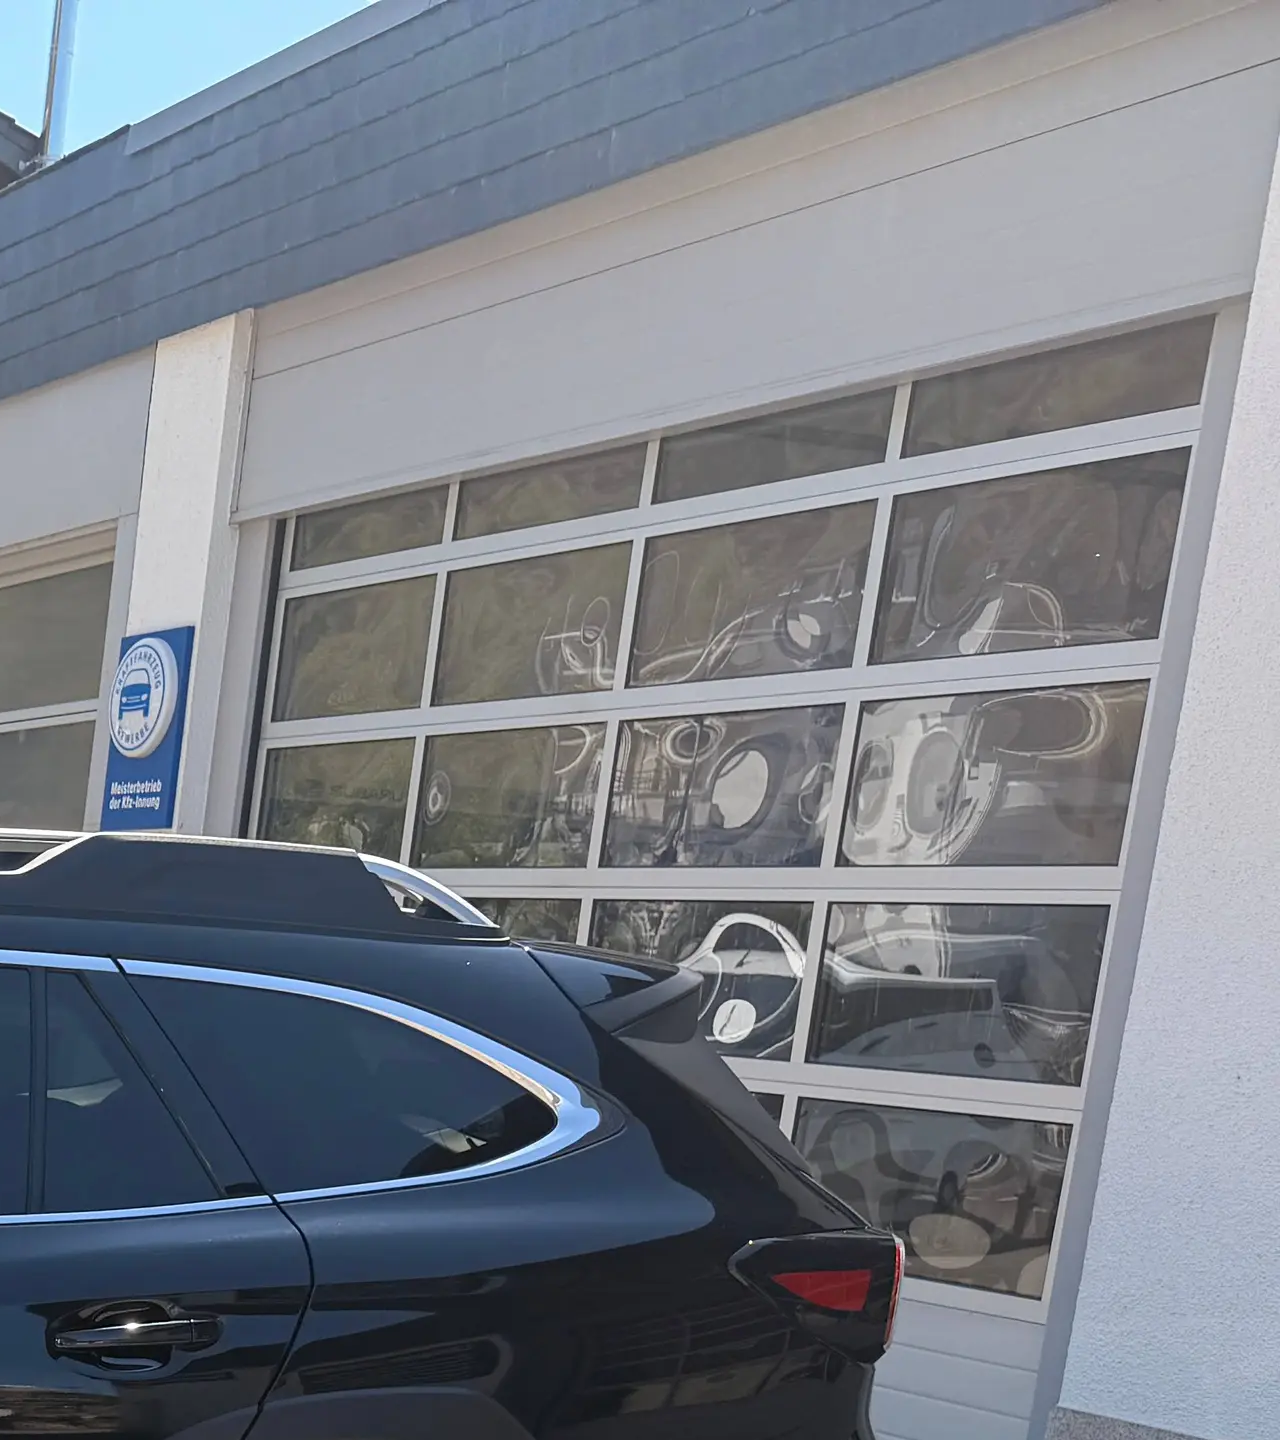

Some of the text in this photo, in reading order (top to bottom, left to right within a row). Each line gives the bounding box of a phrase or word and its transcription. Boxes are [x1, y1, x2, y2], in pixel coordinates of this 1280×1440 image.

[116, 721, 150, 745] GEWERBE
[110, 779, 162, 796] Meisterbetrieb
[109, 795, 161, 811] der Kfz-Innung
